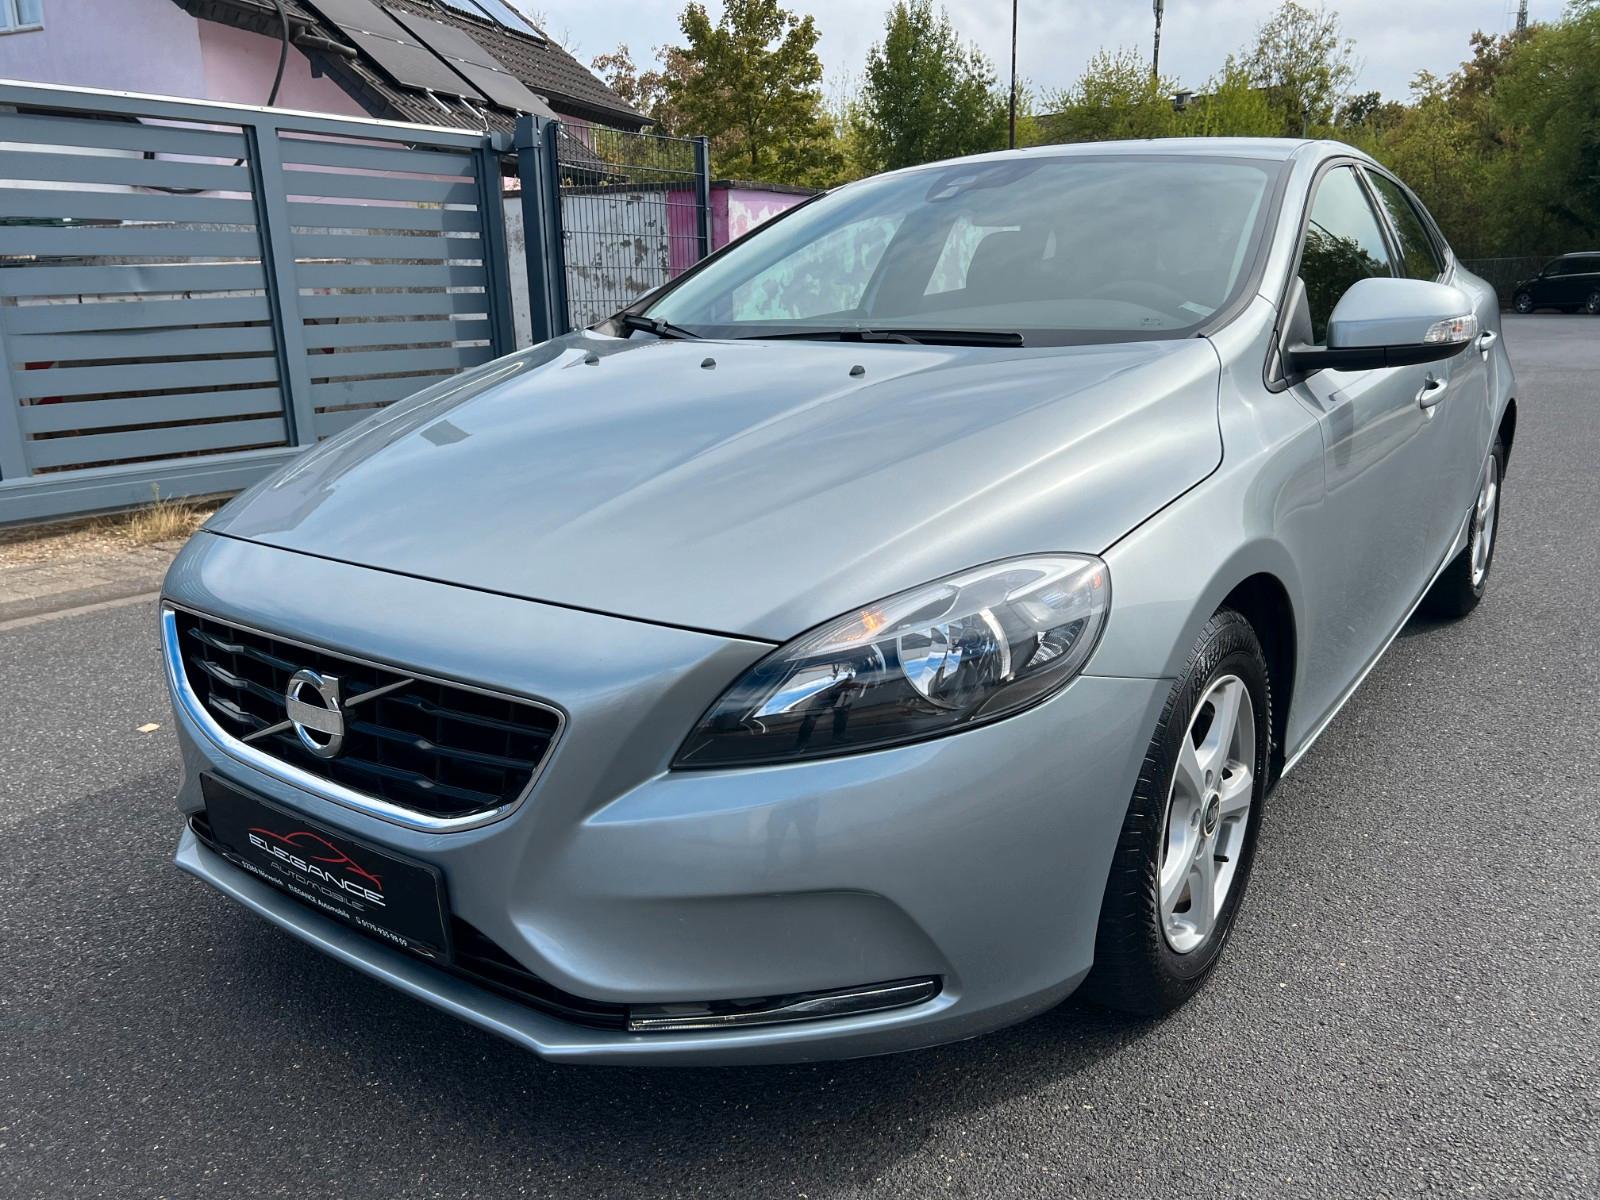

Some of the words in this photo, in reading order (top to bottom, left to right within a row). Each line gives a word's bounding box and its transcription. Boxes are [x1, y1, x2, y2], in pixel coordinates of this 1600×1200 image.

[248, 833, 386, 907] ELEGANCE
[270, 861, 366, 912] AUTOMOBILE
[288, 883, 318, 904] ELEGANCE
[318, 899, 350, 919] Automobile
